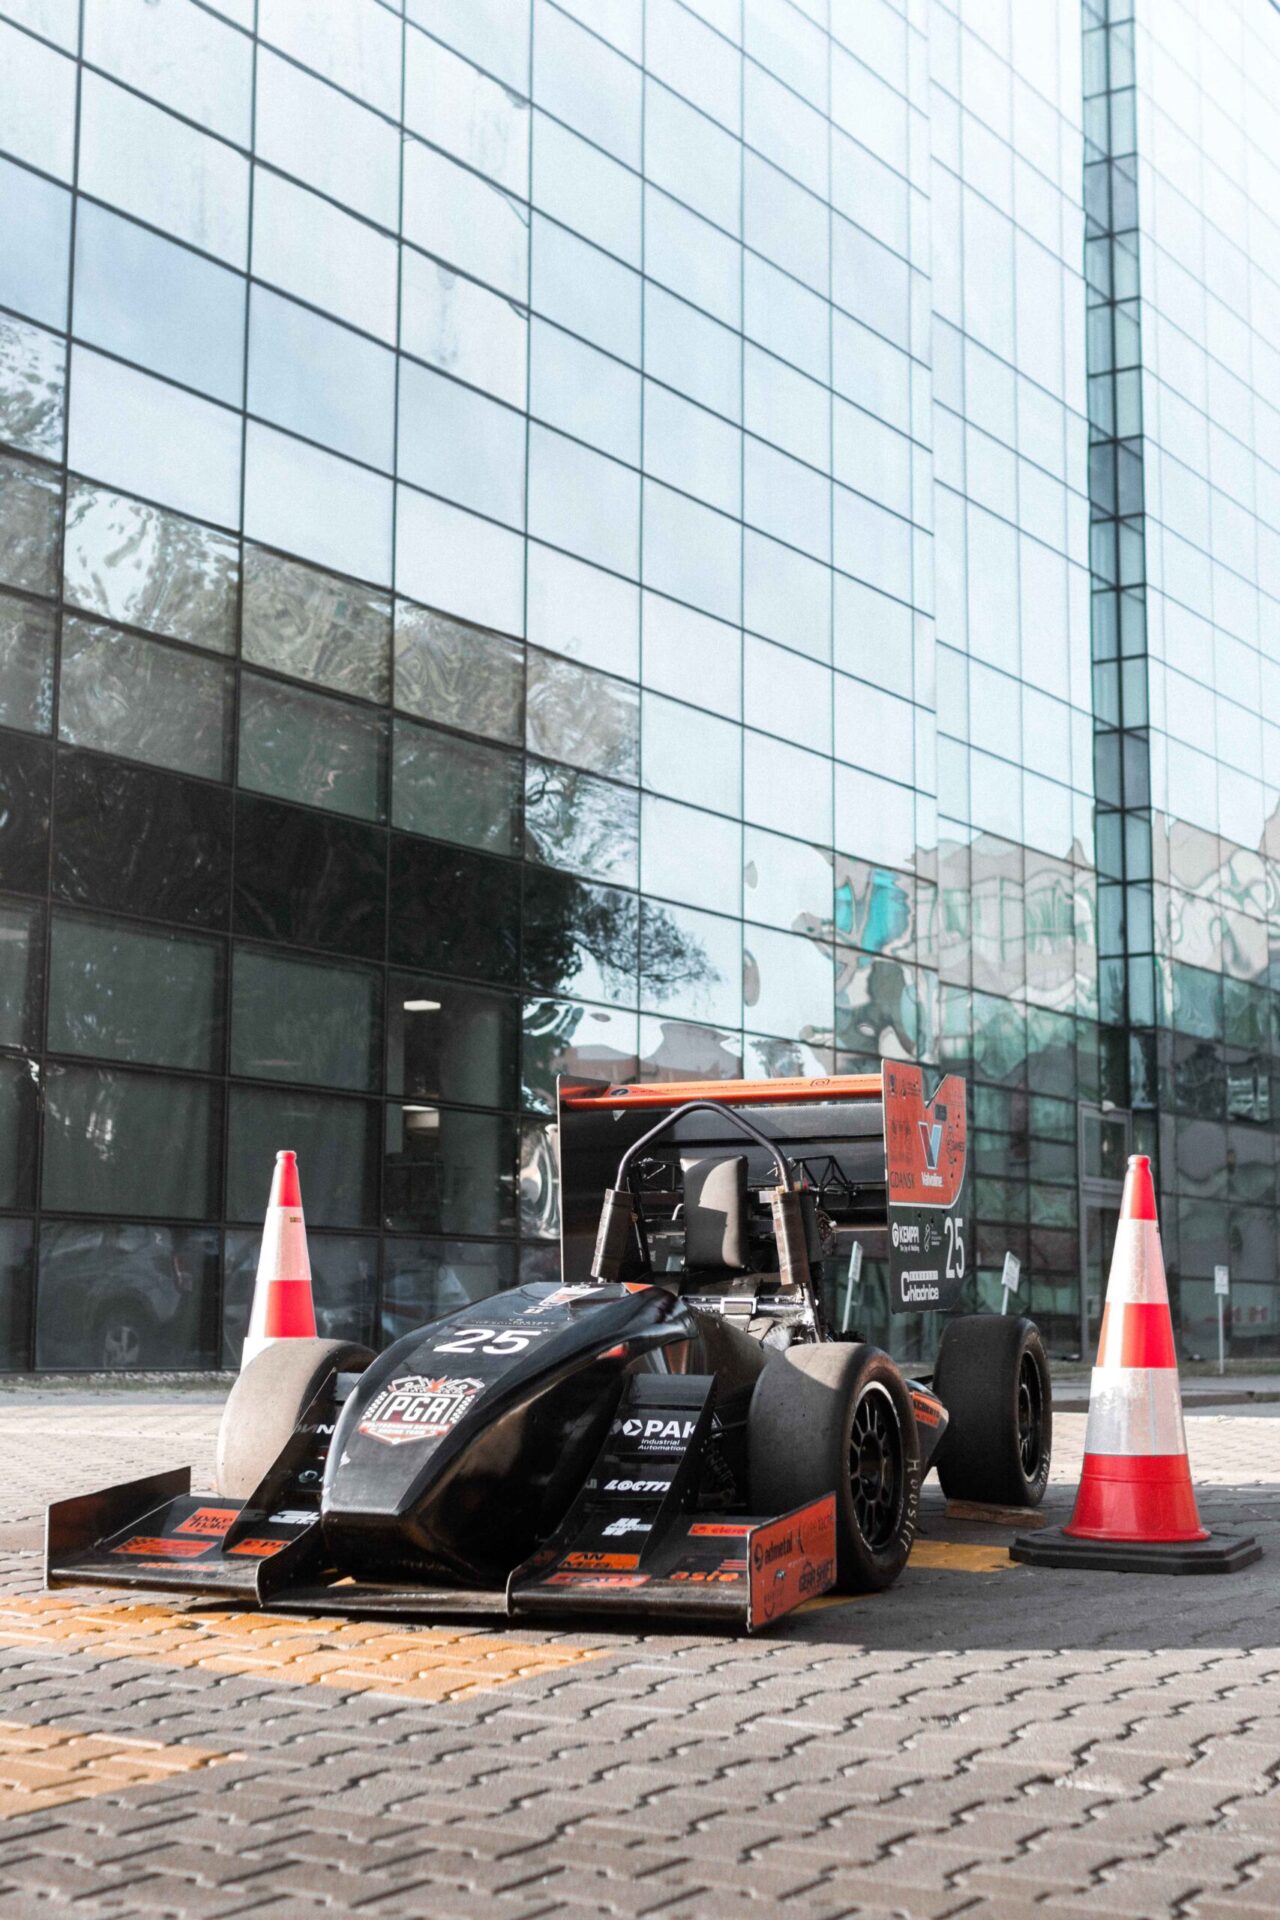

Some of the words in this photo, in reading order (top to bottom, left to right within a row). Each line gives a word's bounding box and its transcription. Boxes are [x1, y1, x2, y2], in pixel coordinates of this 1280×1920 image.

[944, 1217, 965, 1278] 25
[433, 1329, 543, 1354] 25
[382, 1396, 451, 1422] PGR
